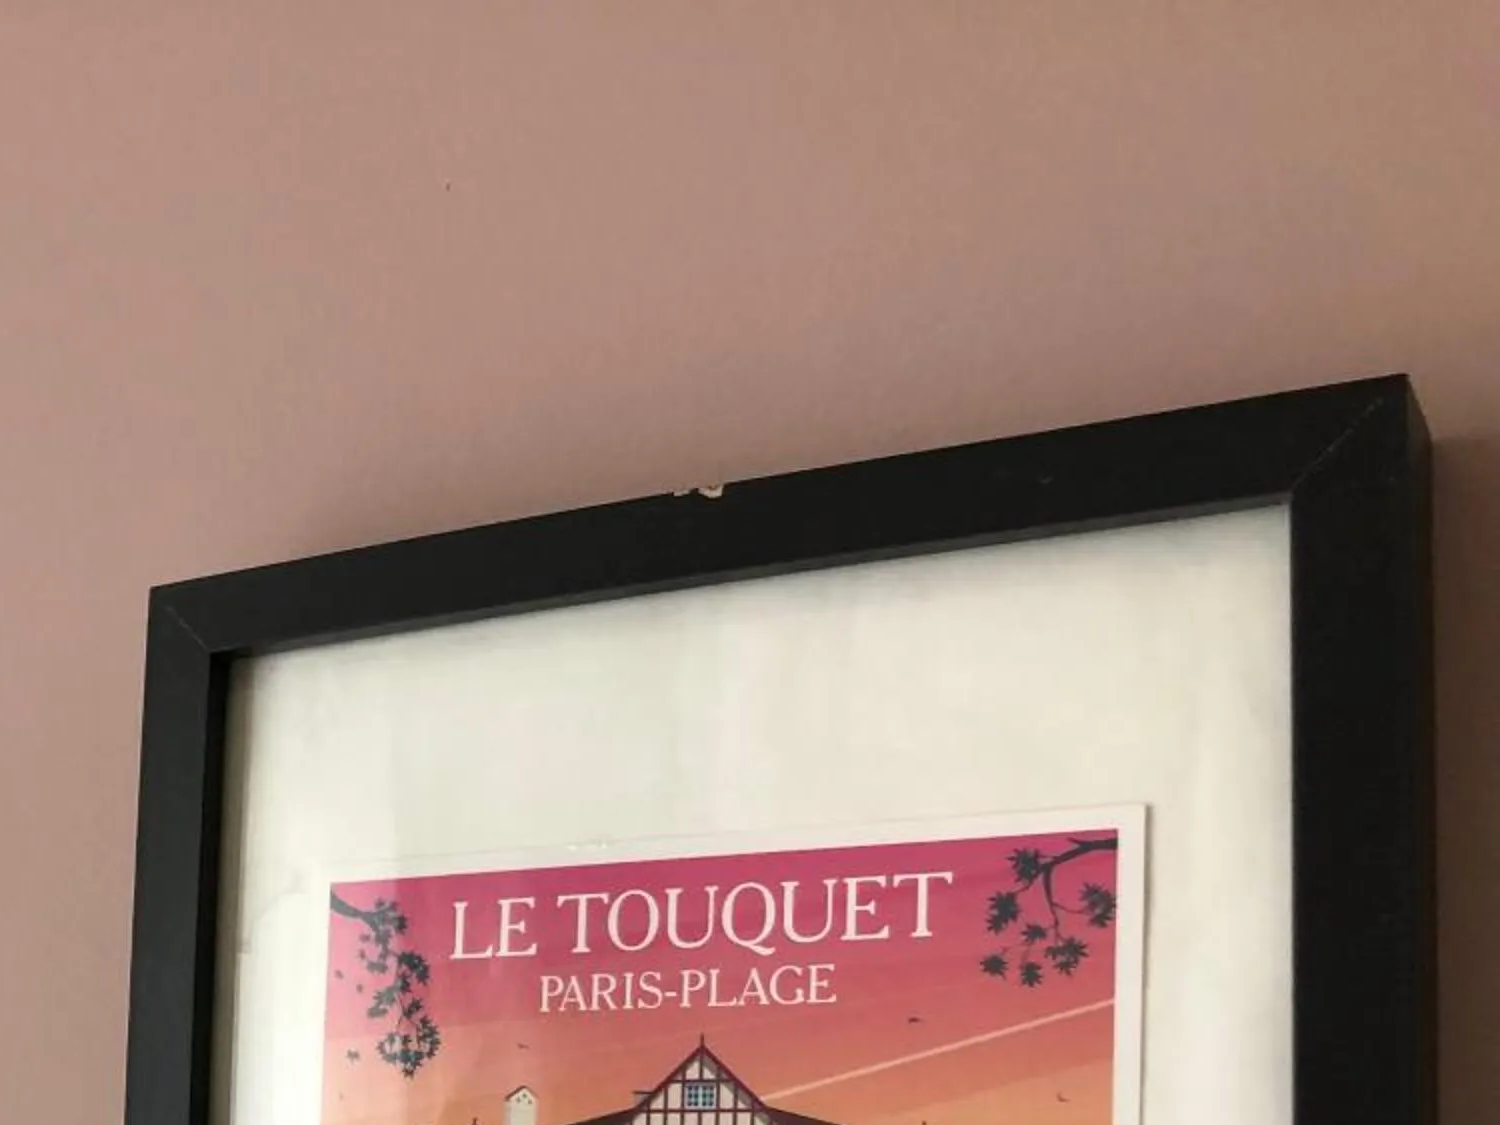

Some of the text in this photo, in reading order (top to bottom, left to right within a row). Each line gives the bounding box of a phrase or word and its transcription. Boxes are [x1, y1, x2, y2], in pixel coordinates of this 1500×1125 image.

[450, 872, 953, 960] LE TOUQUET
[539, 964, 837, 1012] PARIS-PLAGE
